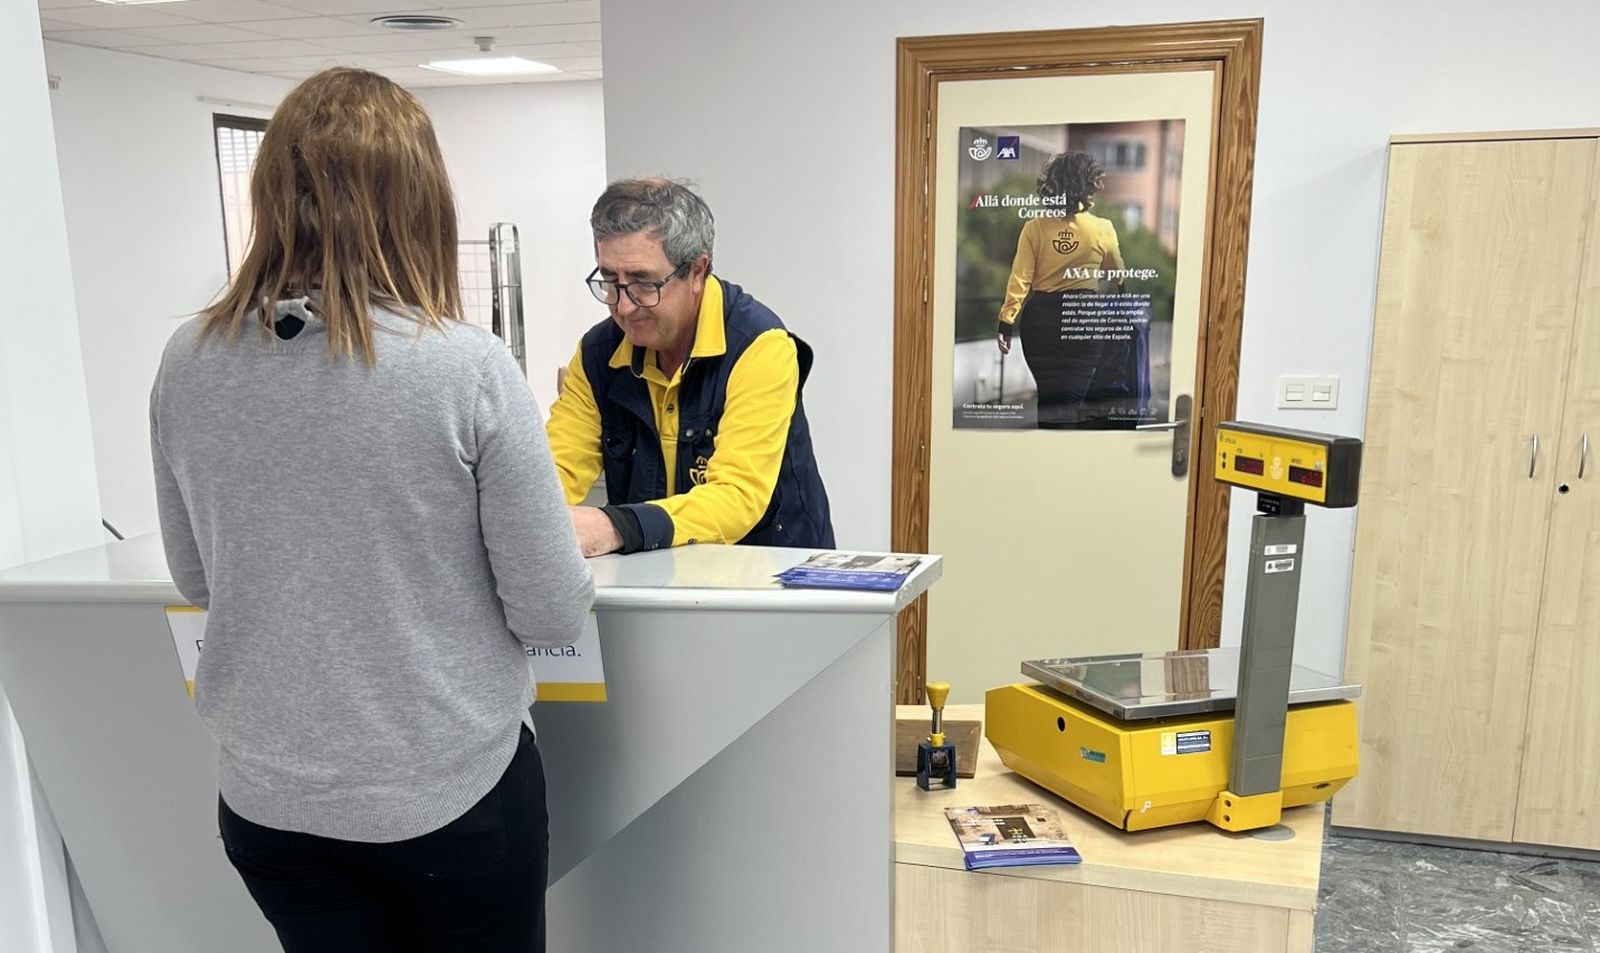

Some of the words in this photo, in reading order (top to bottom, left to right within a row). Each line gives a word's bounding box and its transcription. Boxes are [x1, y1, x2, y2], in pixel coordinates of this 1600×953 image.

[996, 147, 1016, 158] AXA
[975, 195, 999, 207] Allá
[1001, 194, 1040, 207] donde
[1042, 192, 1067, 206] está
[1018, 207, 1067, 219] Correos
[1062, 267, 1091, 279] AXA
[1093, 268, 1105, 278] te
[1107, 267, 1159, 281] protege.
